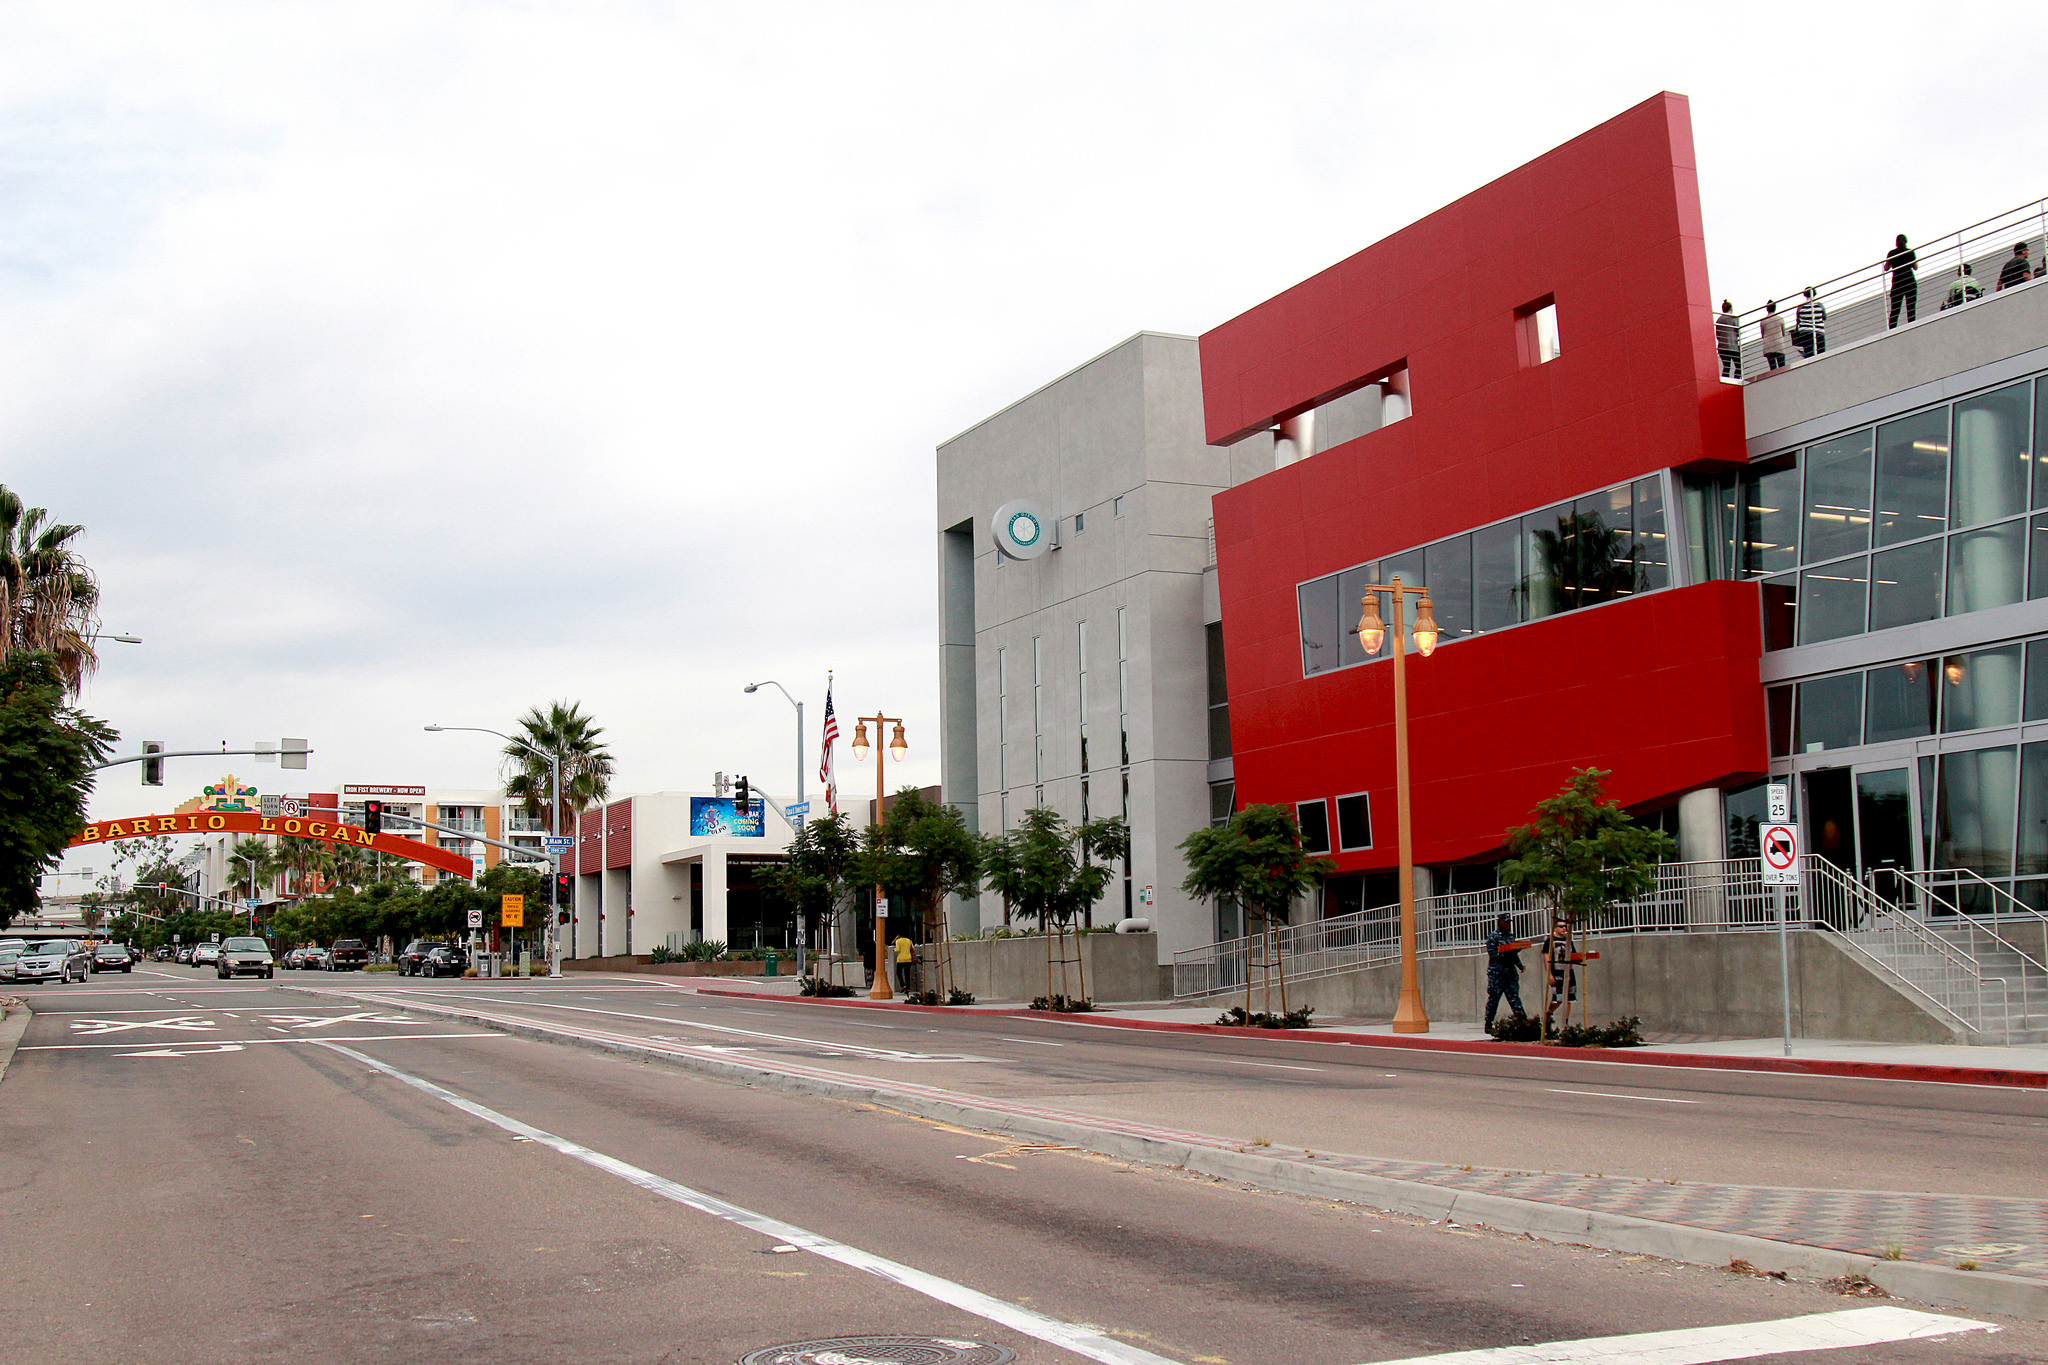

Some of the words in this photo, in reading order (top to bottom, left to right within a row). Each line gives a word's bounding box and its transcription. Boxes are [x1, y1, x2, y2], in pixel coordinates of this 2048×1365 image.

[1772, 804, 1785, 816] 25
[82, 815, 225, 842] BARRIO
[260, 818, 376, 846] LOGAN
[706, 825, 727, 835] PULPO
[1778, 872, 1785, 882] 5
